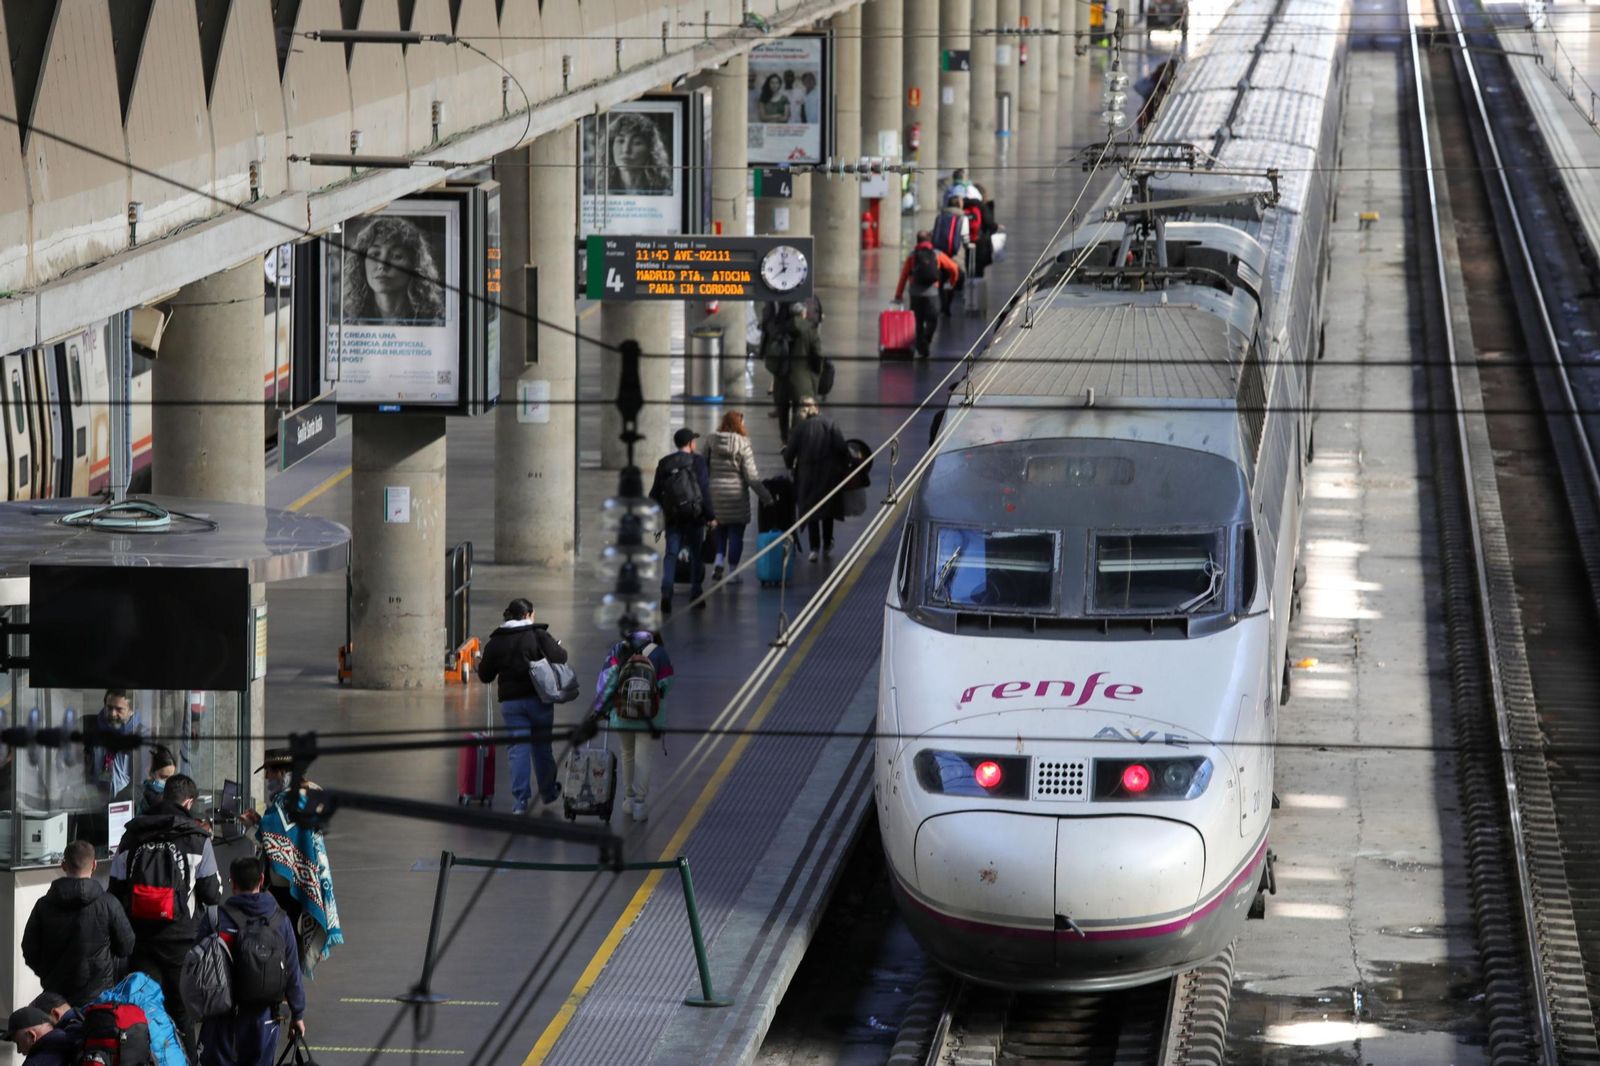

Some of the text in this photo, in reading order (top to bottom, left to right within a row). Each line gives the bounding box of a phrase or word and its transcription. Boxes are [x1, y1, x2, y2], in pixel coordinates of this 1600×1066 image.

[780, 181, 791, 197] 4
[606, 267, 624, 292] 4
[636, 270, 676, 281] MADRID
[712, 270, 751, 282] ATOCHA
[648, 283, 675, 294] PARA
[680, 284, 694, 294] EN
[960, 671, 1144, 708] renfe
[1094, 726, 1189, 749] AVE
